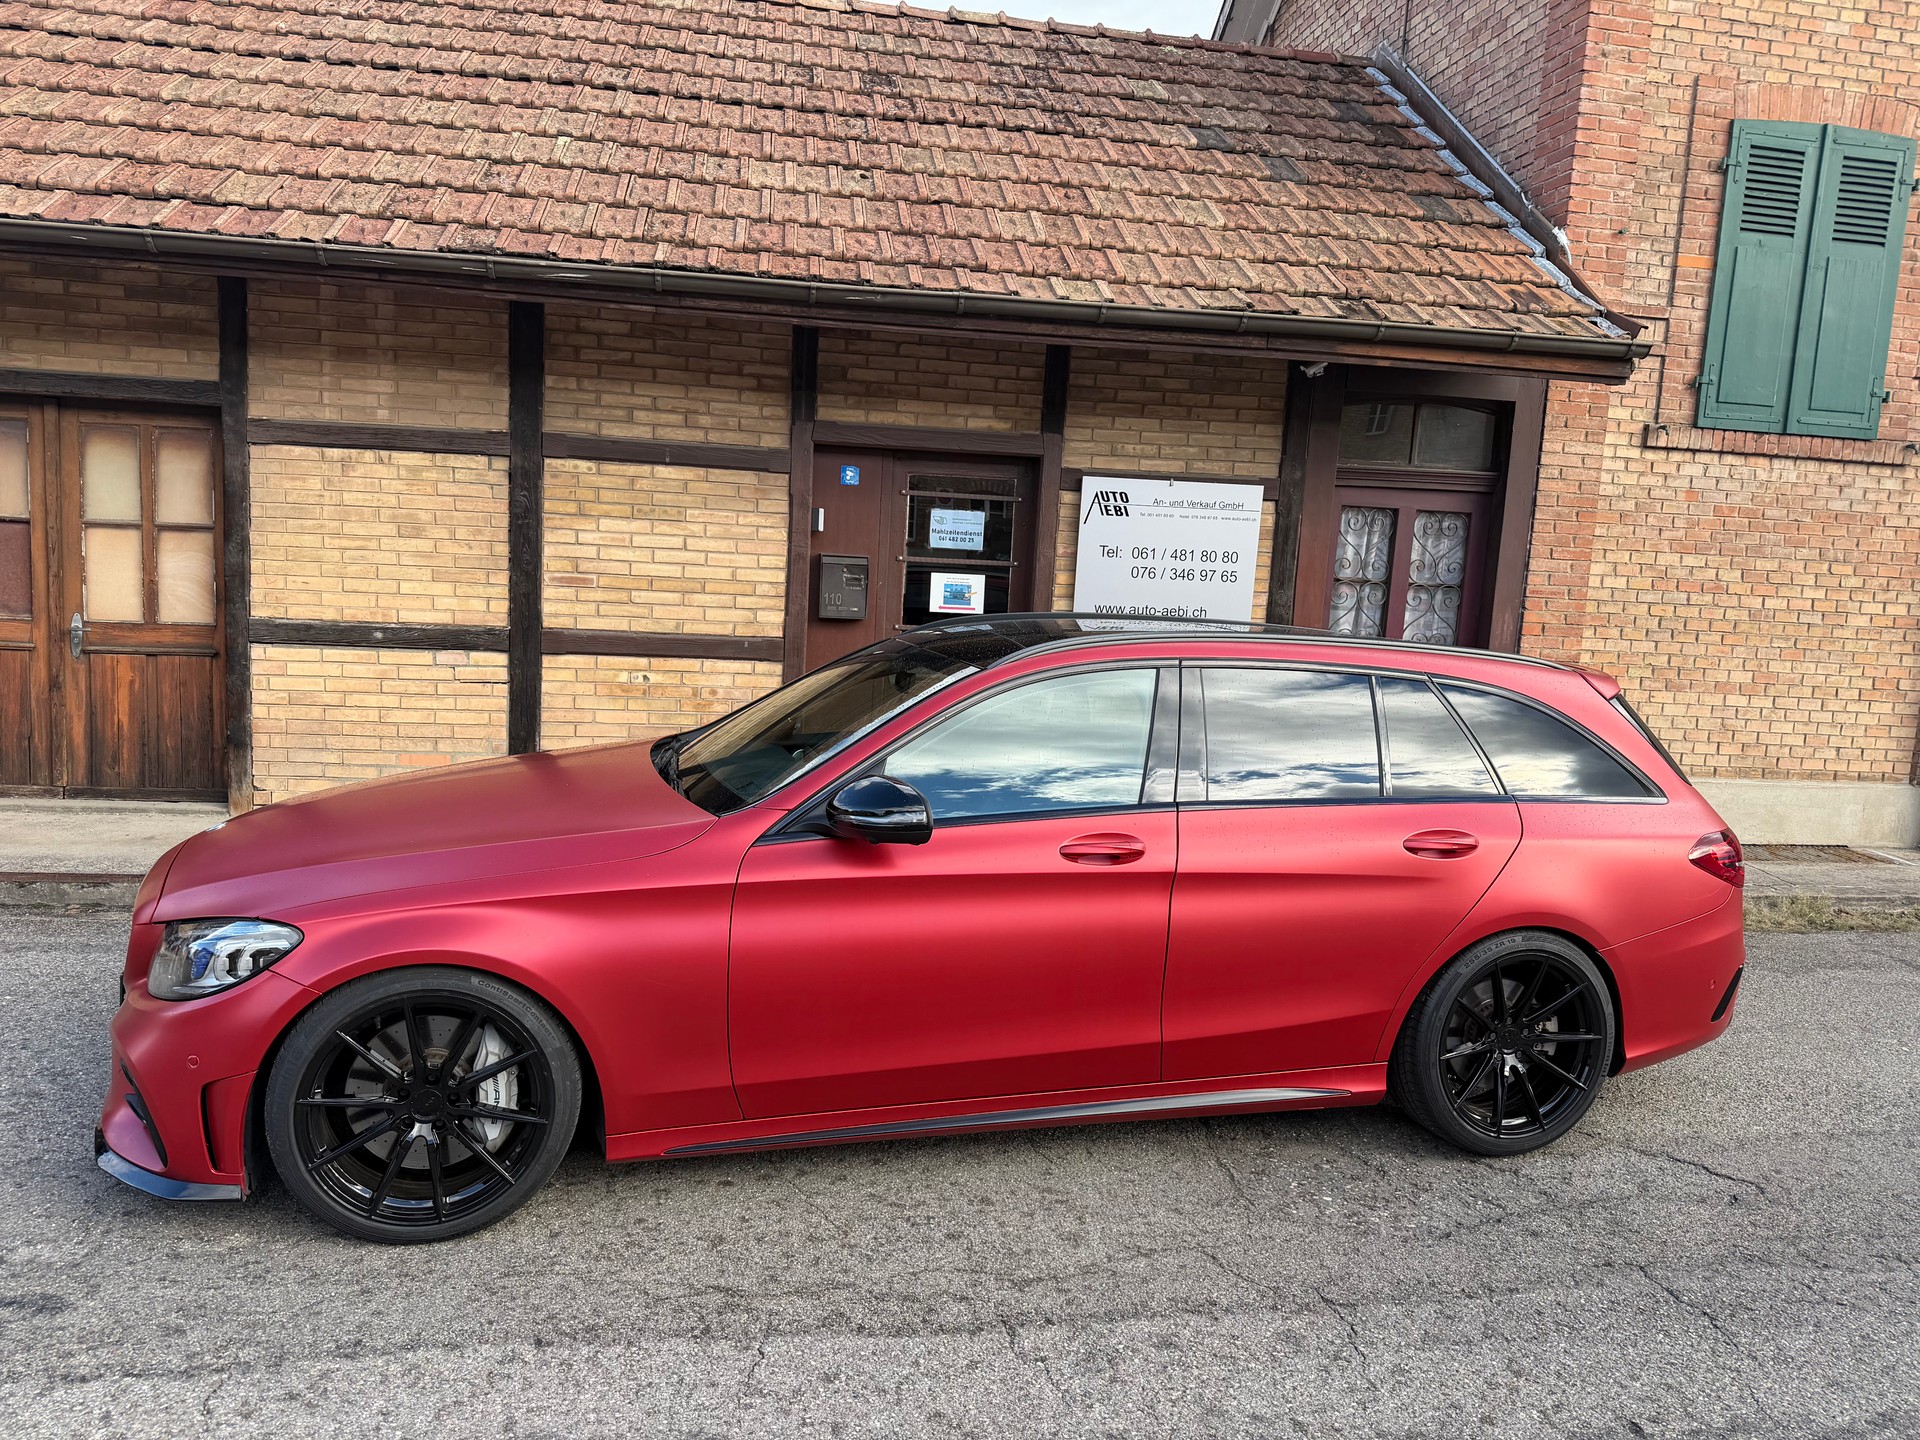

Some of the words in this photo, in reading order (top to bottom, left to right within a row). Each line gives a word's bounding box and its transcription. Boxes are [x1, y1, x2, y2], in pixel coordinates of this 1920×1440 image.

[1152, 497, 1167, 507] An-
[1169, 499, 1184, 508] und
[1186, 499, 1217, 509] Verkauf
[1219, 500, 1244, 510] GmbH
[931, 527, 983, 537] Mahlzeitendienst
[1099, 544, 1122, 559] Tel:
[1131, 546, 1156, 560] 061
[1160, 547, 1167, 561] /
[1169, 548, 1195, 562] 481
[1200, 549, 1217, 563] 80
[1221, 550, 1239, 564] 80
[1131, 565, 1156, 580] 076
[1160, 567, 1167, 580] /
[1169, 567, 1195, 581] 346
[1199, 568, 1217, 582] 97
[1220, 570, 1238, 583] 65
[823, 592, 842, 605] 110
[1094, 604, 1207, 619] www.auto-aebi.ch
[1463, 946, 1493, 969] 255/35
[1493, 940, 1506, 949] ZR
